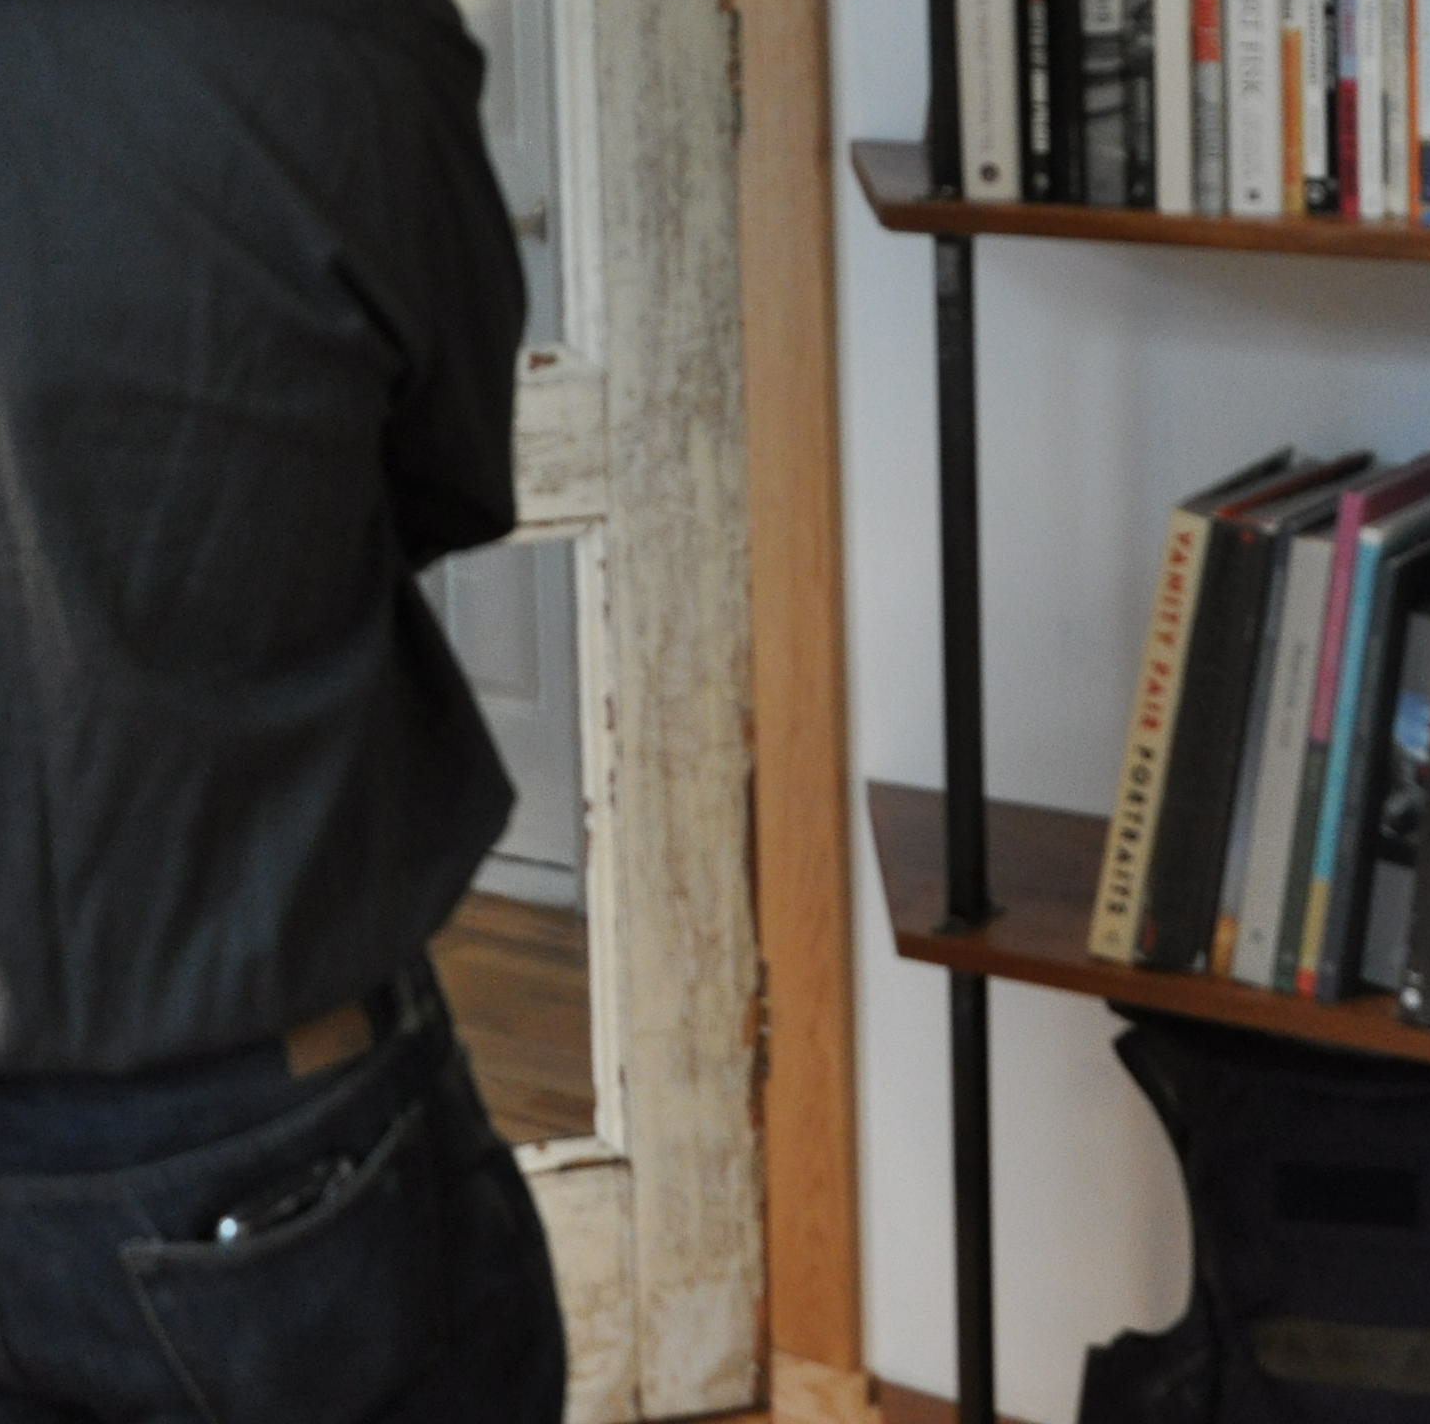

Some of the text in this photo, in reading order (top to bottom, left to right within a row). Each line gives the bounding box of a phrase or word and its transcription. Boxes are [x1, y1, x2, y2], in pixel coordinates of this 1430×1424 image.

[1107, 531, 1195, 914] VANITY FAIR PORTRAITS
